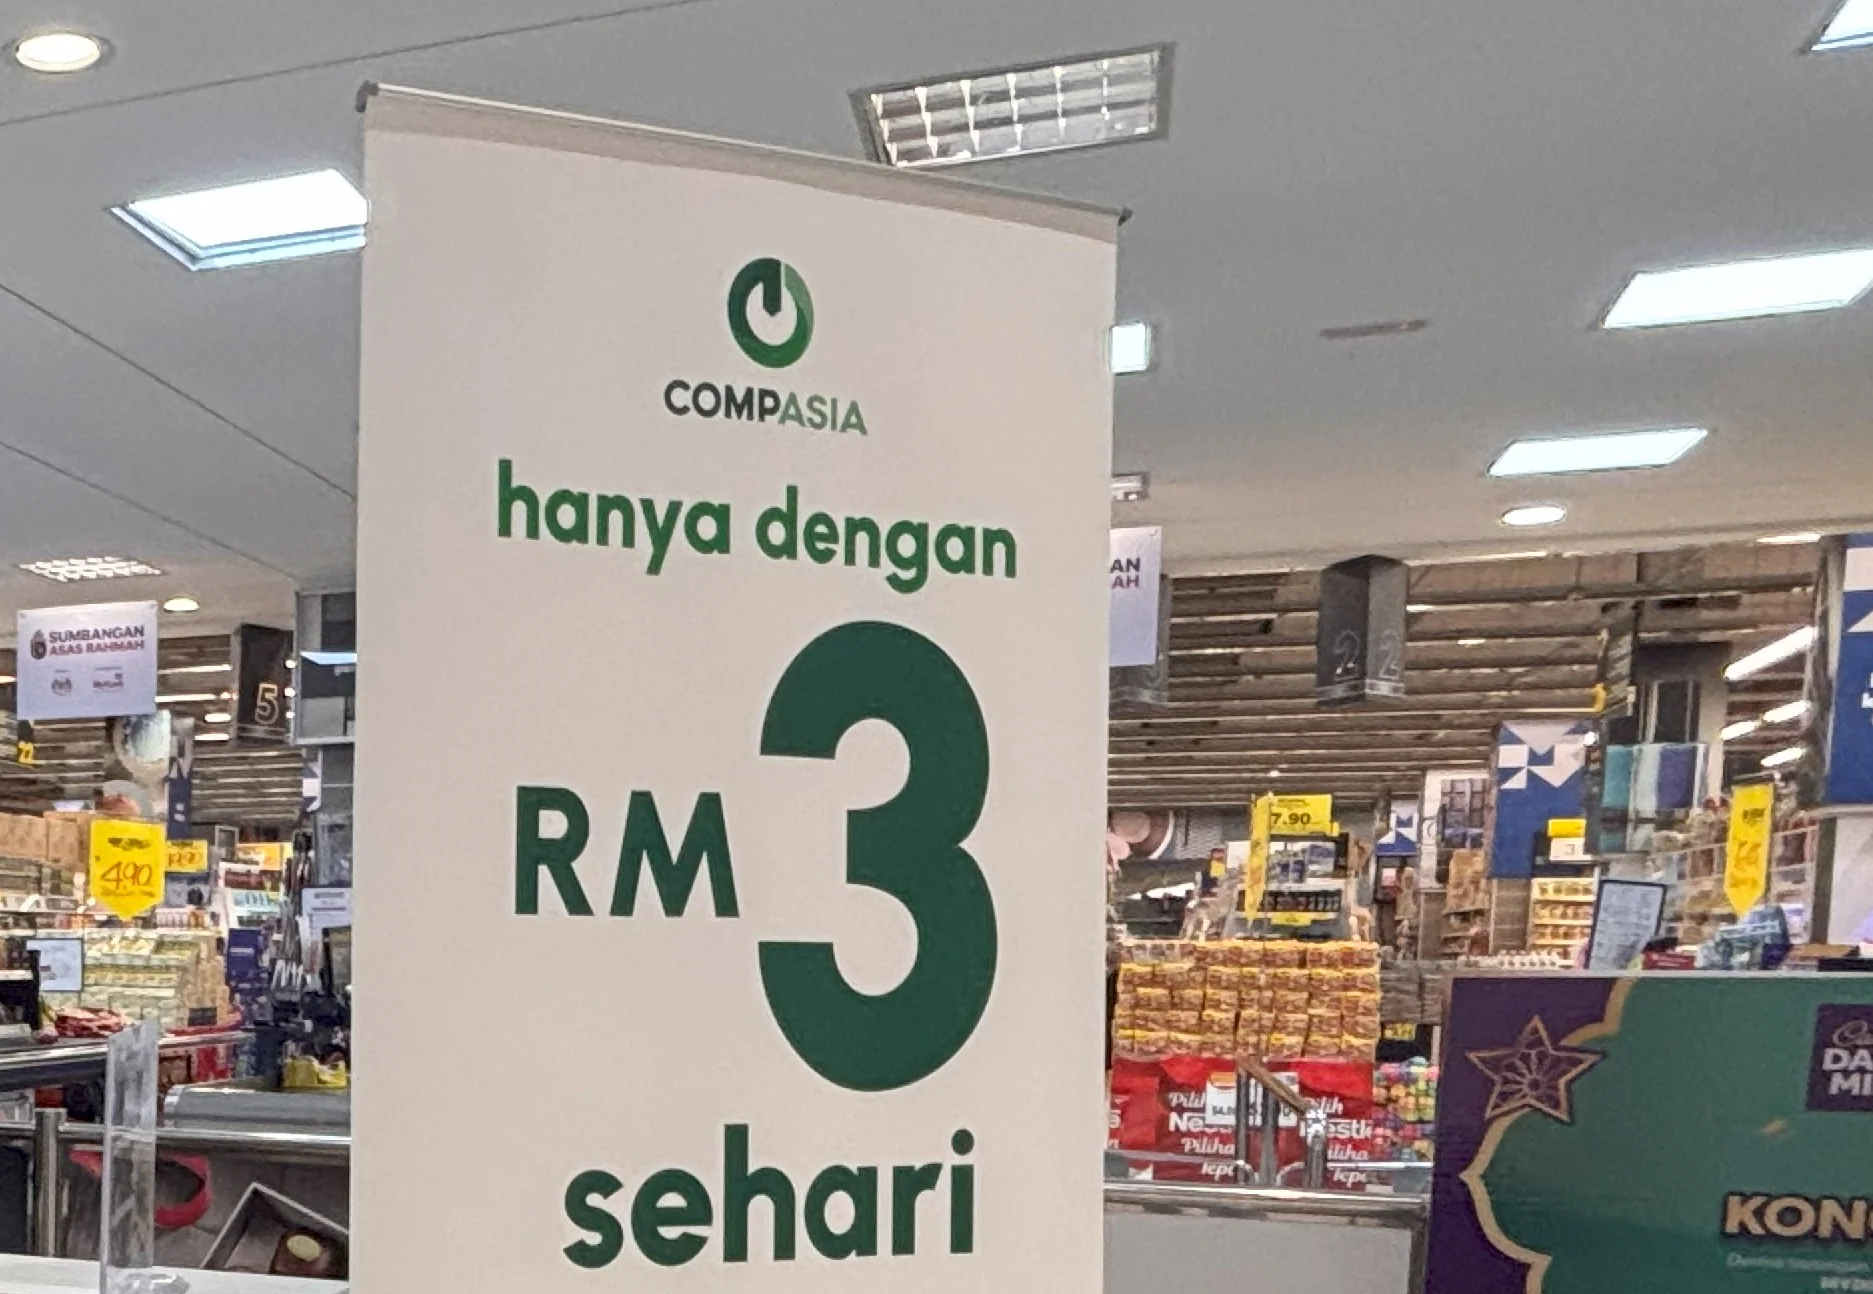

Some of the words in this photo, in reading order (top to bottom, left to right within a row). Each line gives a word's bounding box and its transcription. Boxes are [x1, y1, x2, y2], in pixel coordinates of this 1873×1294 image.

[664, 379, 868, 436] COMPASIA
[498, 459, 730, 576] hanya
[755, 485, 1018, 595] dengan
[49, 624, 145, 643] SUMBANGAN
[49, 643, 83, 656] ASAS
[86, 640, 145, 653] RAHMAH
[254, 683, 279, 725] 5
[562, 1123, 975, 1269] sehari
[1725, 1194, 1873, 1240] KON
